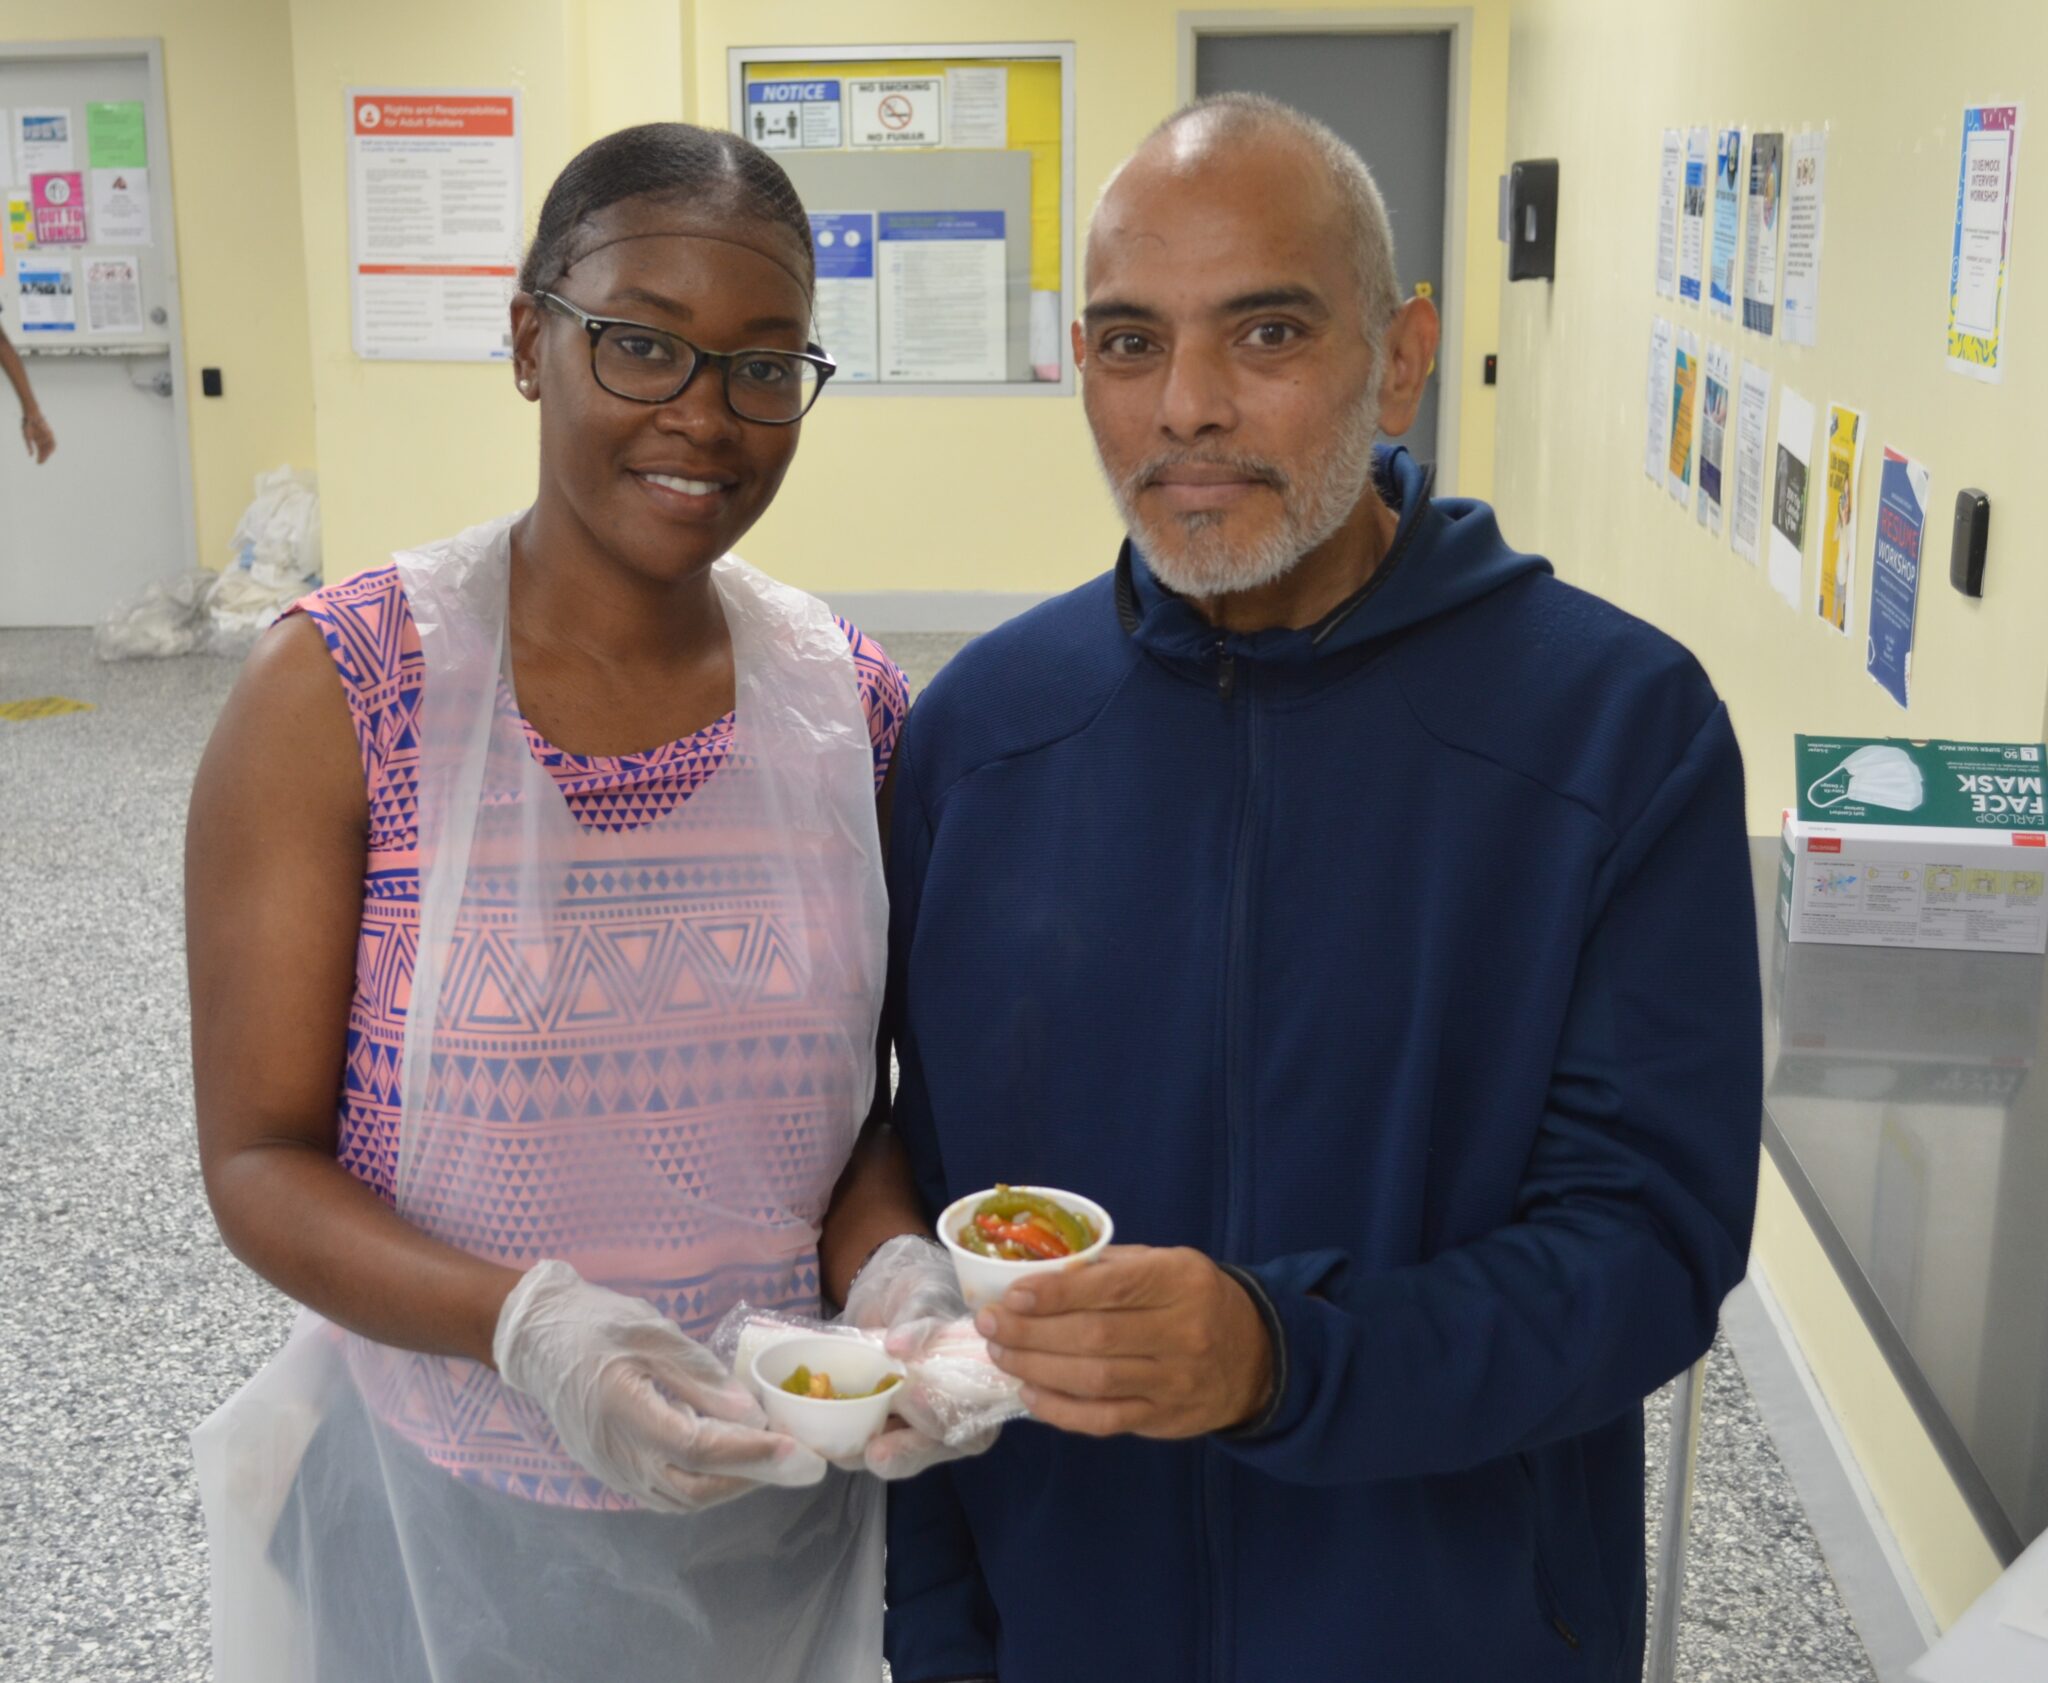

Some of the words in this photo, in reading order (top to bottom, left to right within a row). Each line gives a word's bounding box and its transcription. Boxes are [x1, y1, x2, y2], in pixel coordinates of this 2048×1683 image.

[762, 84, 826, 101] NOTICE
[859, 84, 875, 93] NO
[878, 82, 931, 93] SMOKING
[383, 104, 413, 116] Rights
[416, 104, 433, 115] and
[435, 104, 508, 116] Responsibilities
[383, 117, 397, 127] for
[399, 117, 425, 127] Adult
[425, 118, 465, 128] Shelters
[867, 133, 883, 142] NO
[886, 132, 925, 141] FUMAR
[1971, 174, 1999, 187] INTERVIEW
[1970, 189, 1999, 203] WORKSHOP
[38, 207, 64, 224] OUT
[66, 207, 83, 223] TO
[38, 225, 84, 241] LUNCH
[1881, 507, 1920, 560] RESUME
[1878, 538, 1916, 585] WORKSHOP
[2004, 751, 2018, 759] 50
[2025, 751, 2032, 759] L
[1957, 774, 2042, 794] MASK
[1971, 794, 2044, 814] FACE
[1975, 813, 2045, 825] EARLOOP
